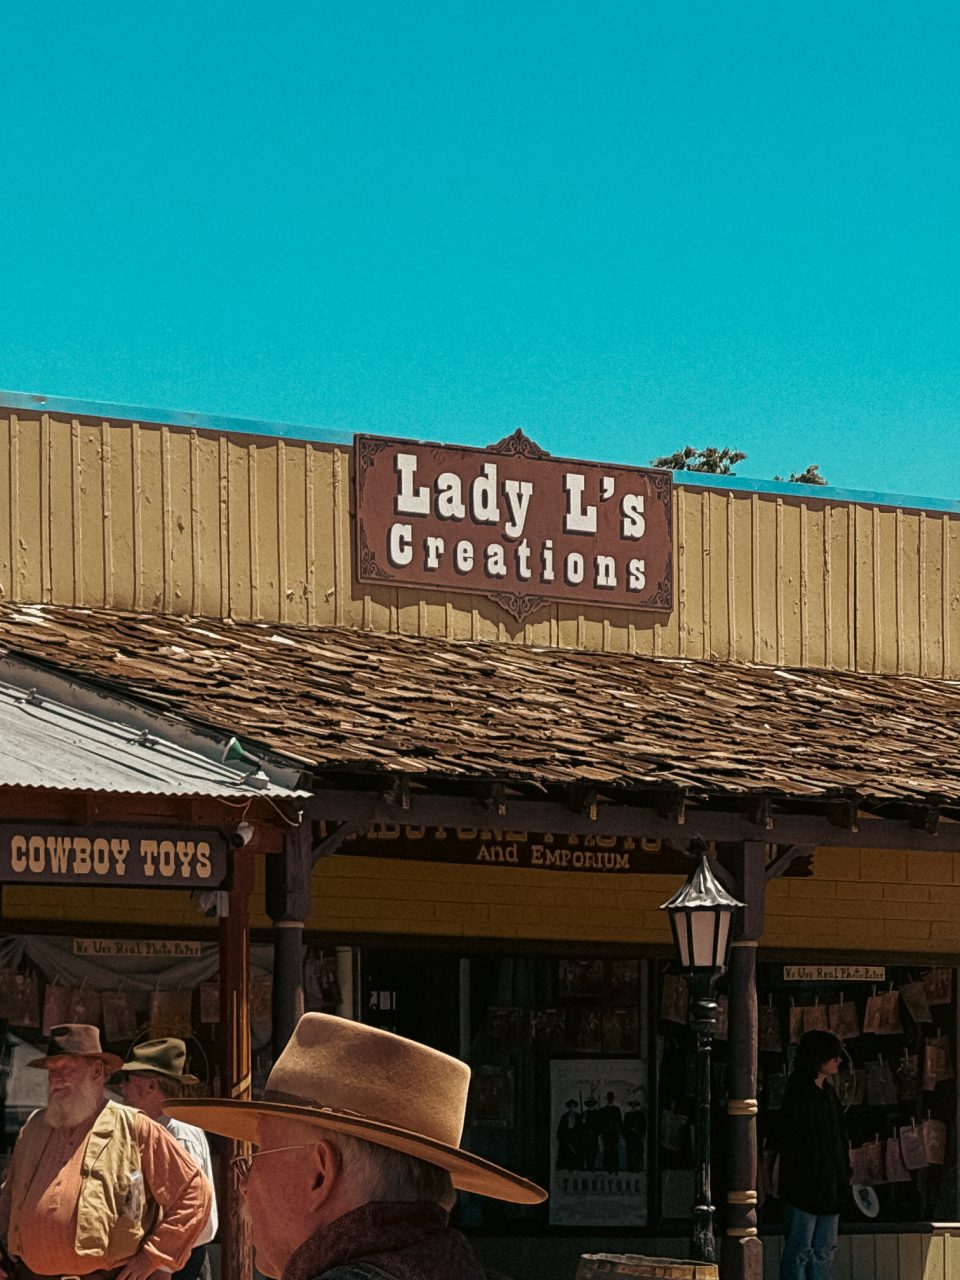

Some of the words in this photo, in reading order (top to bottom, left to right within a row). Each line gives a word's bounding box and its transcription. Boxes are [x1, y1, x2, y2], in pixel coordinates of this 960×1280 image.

[396, 453, 533, 538] Lady
[565, 473, 646, 539] L's
[390, 523, 646, 590] Creations
[10, 834, 130, 876] COWBOY
[141, 839, 212, 878] TOYS
[477, 845, 520, 863] And
